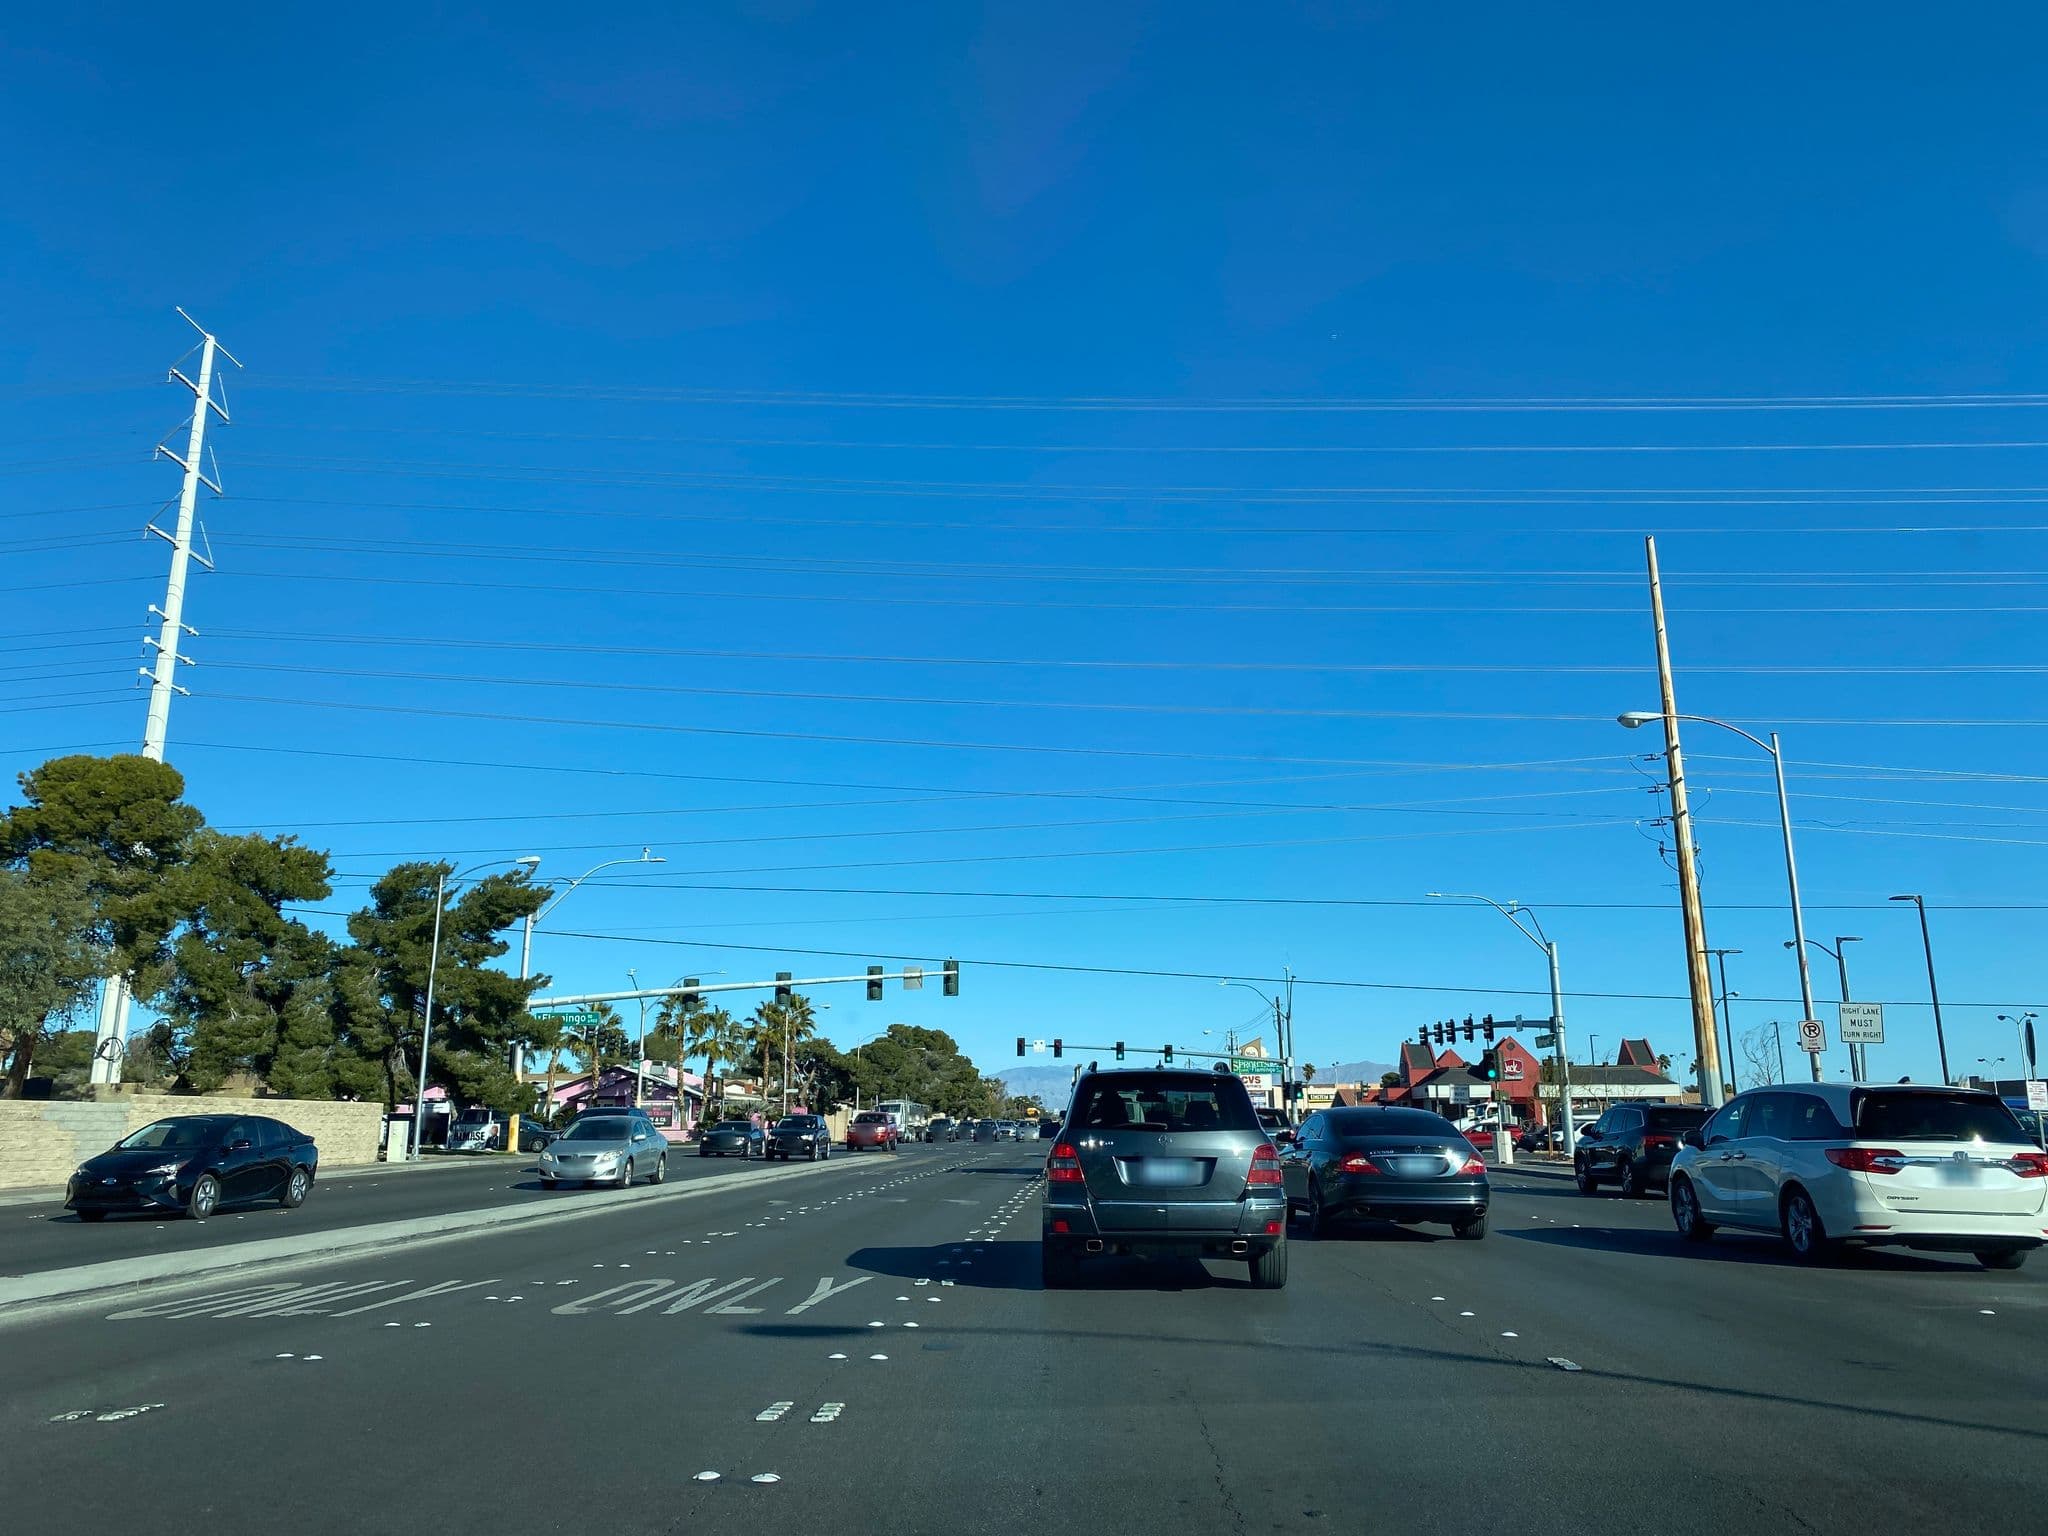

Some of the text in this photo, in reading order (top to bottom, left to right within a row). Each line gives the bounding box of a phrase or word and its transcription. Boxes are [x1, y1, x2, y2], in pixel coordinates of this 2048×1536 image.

[1862, 1008, 1880, 1016] LANE
[542, 1013, 586, 1026] Flingo
[1241, 1075, 1261, 1084] CVS
[105, 1279, 502, 1319] ONLY
[551, 1277, 872, 1315] ONLY
